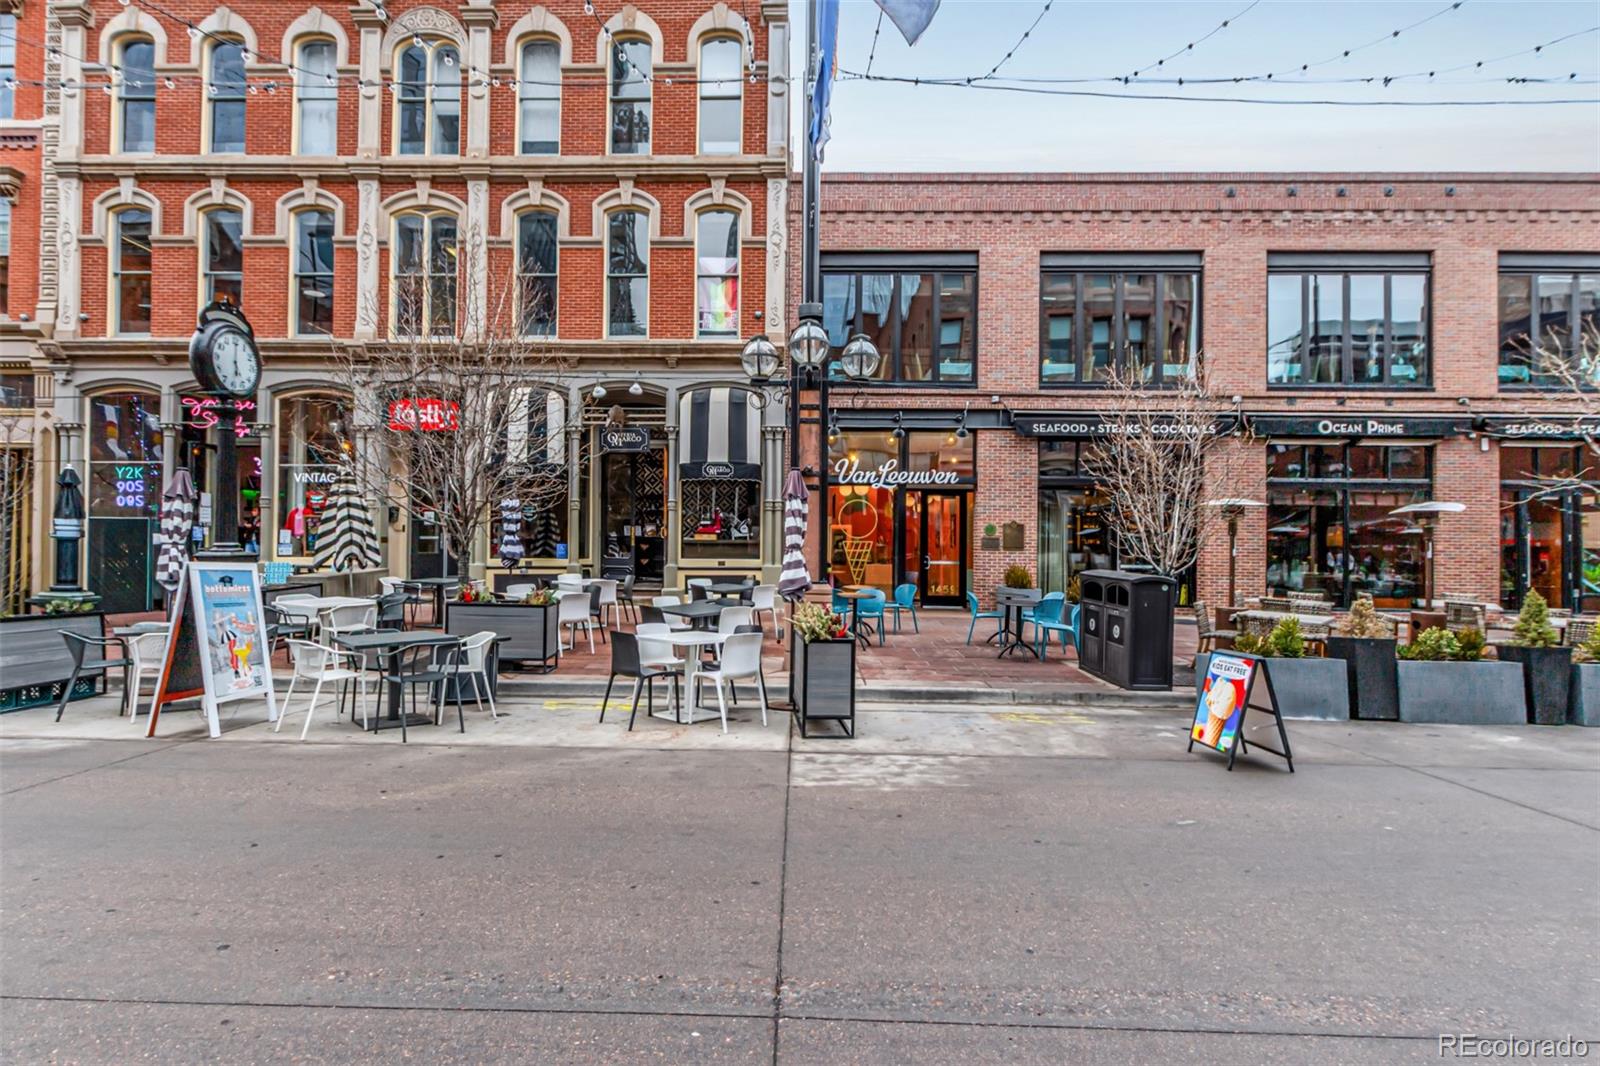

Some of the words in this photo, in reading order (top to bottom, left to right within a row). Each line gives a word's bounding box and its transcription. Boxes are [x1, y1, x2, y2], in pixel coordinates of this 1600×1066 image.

[1032, 423, 1088, 433] SEAFOOD
[1098, 423, 1141, 433] STEKS
[1151, 424, 1216, 434] COCKTALS
[115, 466, 144, 479] Y2K
[835, 459, 879, 484] Van
[872, 459, 959, 488] Leeuwen
[116, 480, 144, 492] 90S
